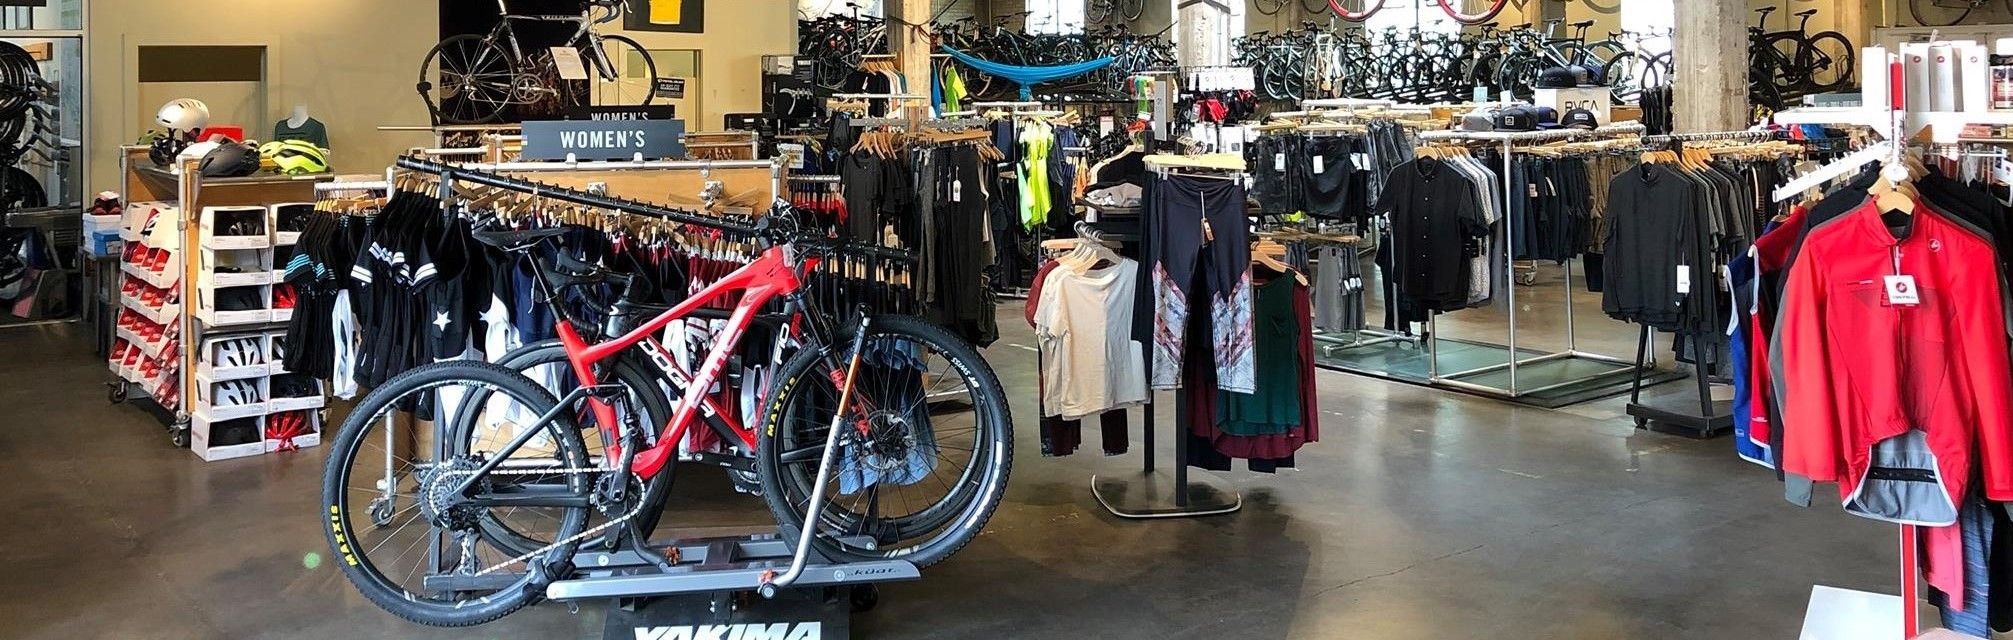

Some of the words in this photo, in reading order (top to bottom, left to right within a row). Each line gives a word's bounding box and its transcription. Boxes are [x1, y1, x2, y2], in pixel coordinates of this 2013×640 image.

[560, 130, 645, 149] WOMEN'S
[767, 377, 796, 437] MAXXIS
[330, 505, 358, 567] MAXXIS
